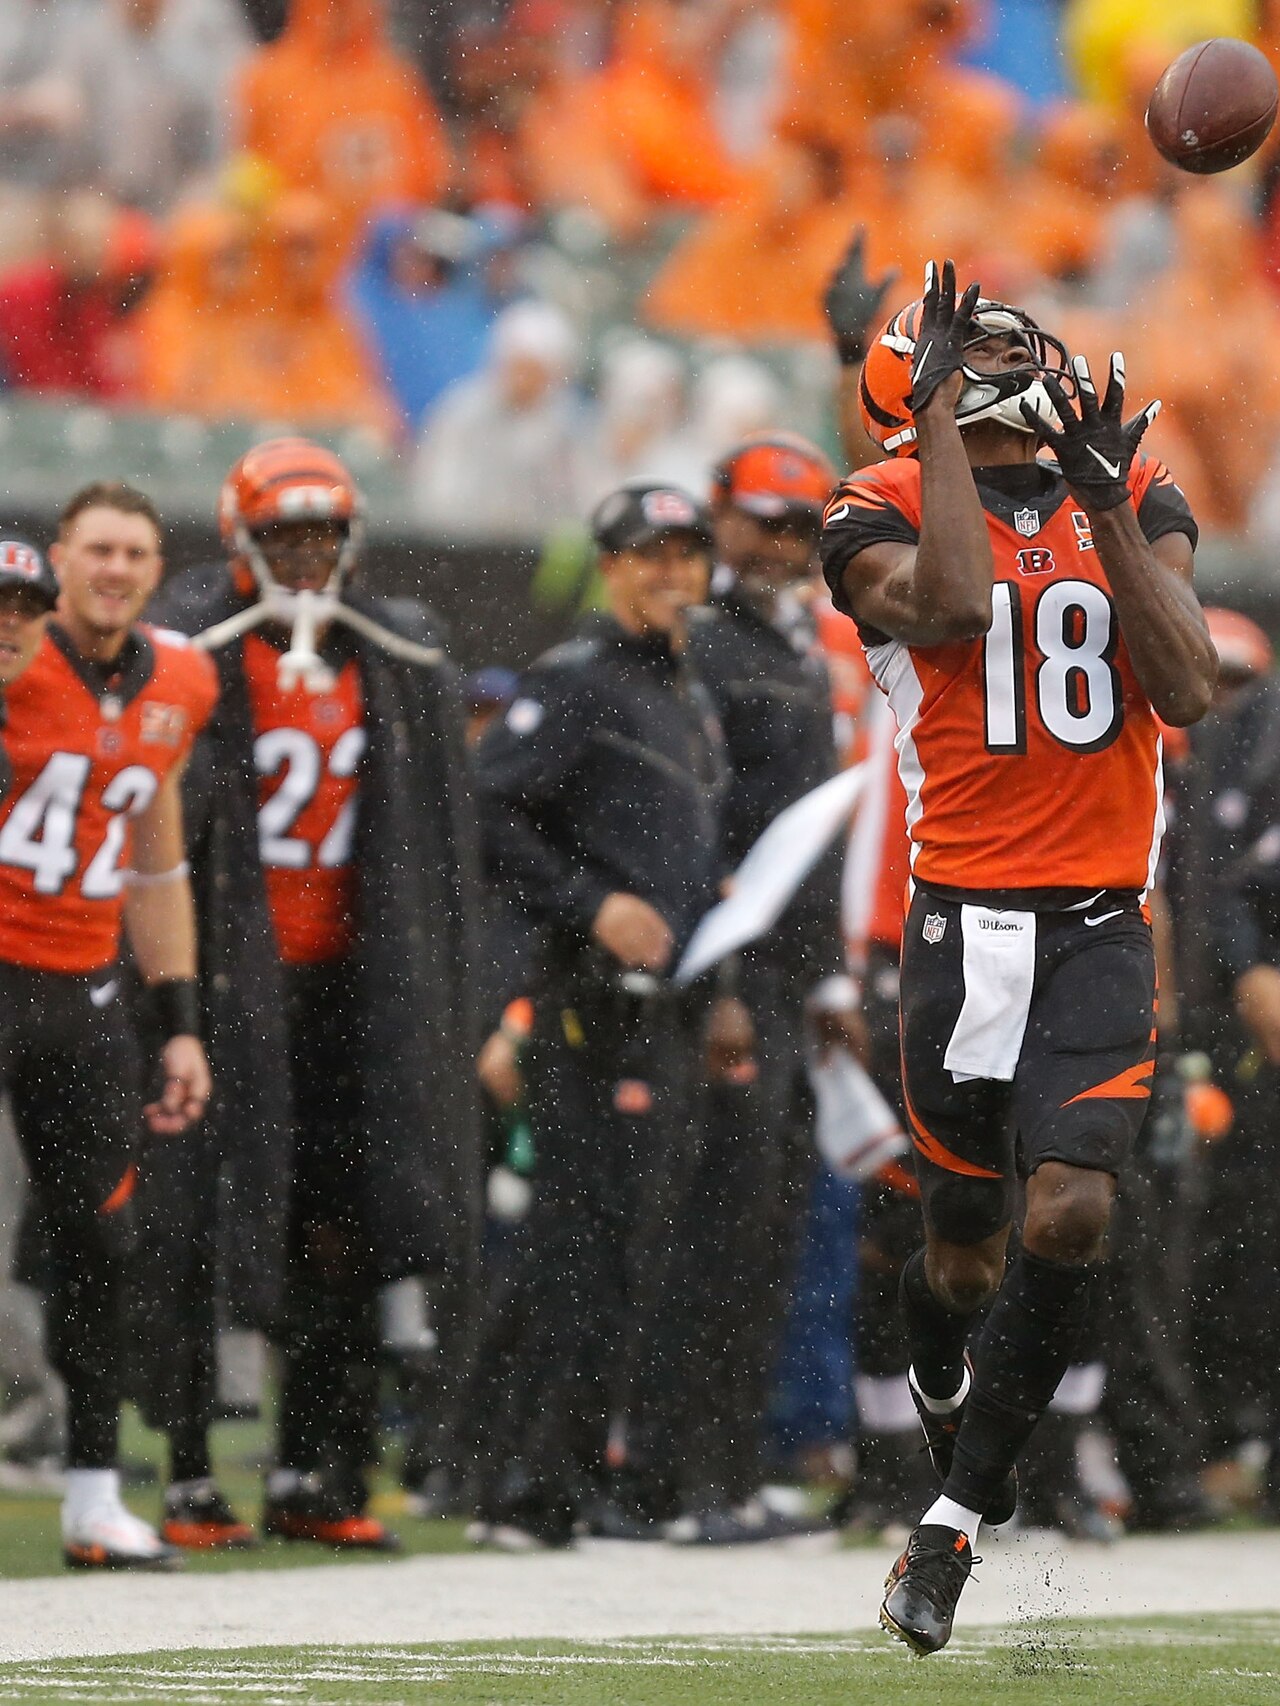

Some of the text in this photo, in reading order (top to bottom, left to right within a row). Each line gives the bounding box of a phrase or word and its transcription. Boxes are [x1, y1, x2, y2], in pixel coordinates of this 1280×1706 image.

[981, 578, 1123, 755] 18
[0, 750, 158, 899] 42
[977, 918, 1020, 932] Wilson
